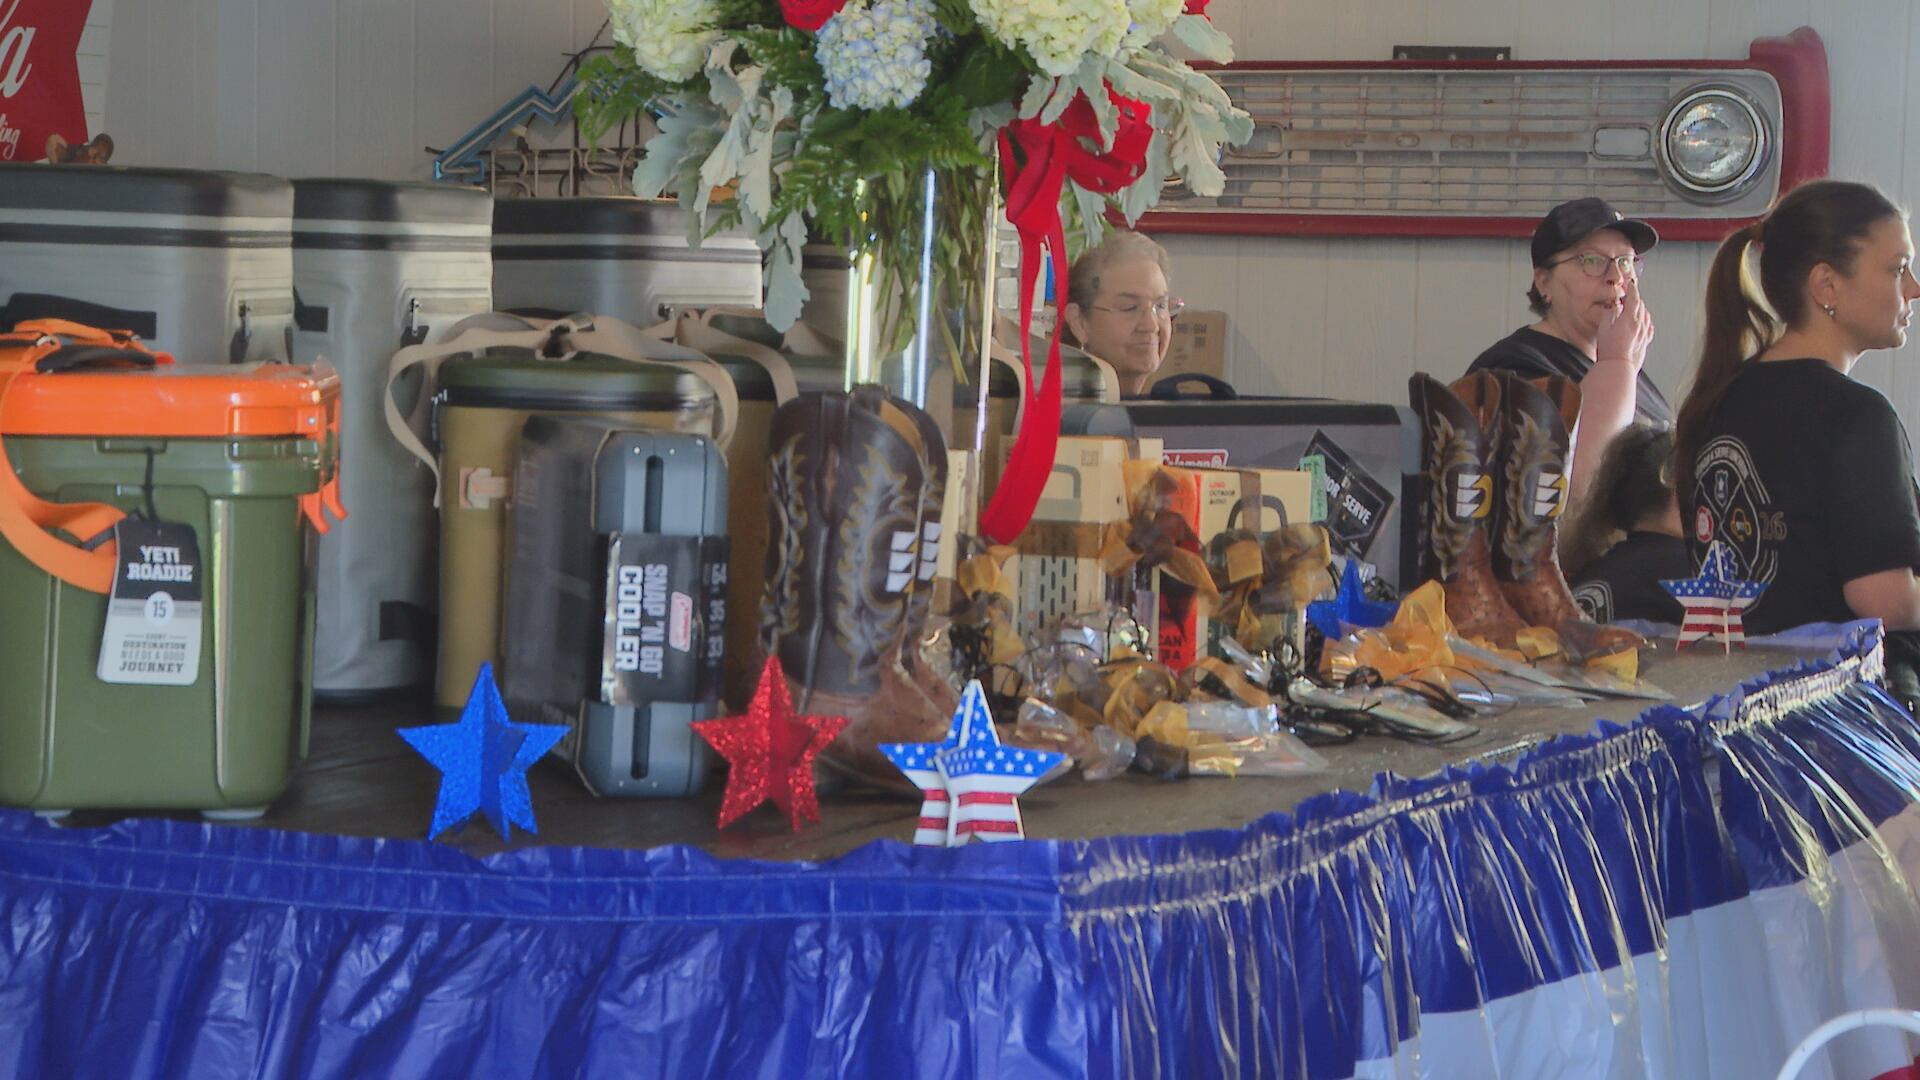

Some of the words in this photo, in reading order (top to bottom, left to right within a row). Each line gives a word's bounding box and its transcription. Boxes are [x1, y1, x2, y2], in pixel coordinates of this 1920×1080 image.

[1342, 494, 1372, 525] SERVE
[140, 545, 180, 563] YETI
[127, 562, 193, 582] ROADIE
[642, 563, 668, 617] SNAP
[152, 601, 167, 618] 15
[615, 564, 643, 672] COOLER
[122, 640, 187, 650] DESTINATION
[119, 661, 185, 673] JOURNEY
